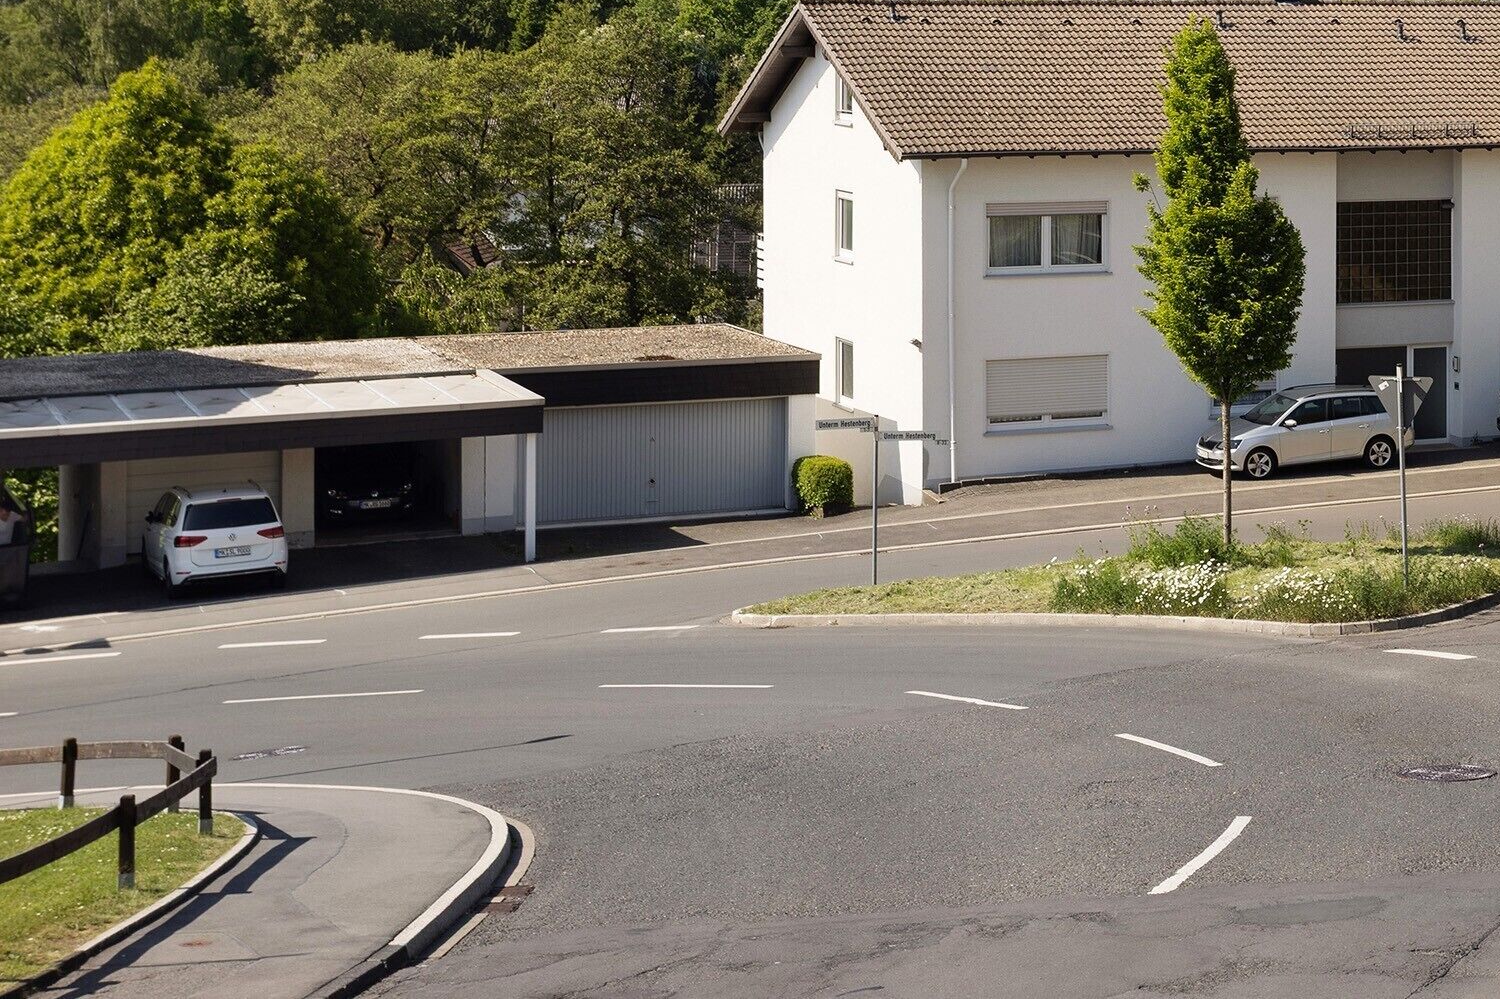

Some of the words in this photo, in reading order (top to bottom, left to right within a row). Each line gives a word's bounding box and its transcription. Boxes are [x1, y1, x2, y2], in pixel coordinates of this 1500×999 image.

[819, 421, 839, 429] Unterm
[841, 419, 871, 428] Hestenberg
[884, 432, 903, 440] Unterm
[905, 432, 936, 441] Hestenberg
